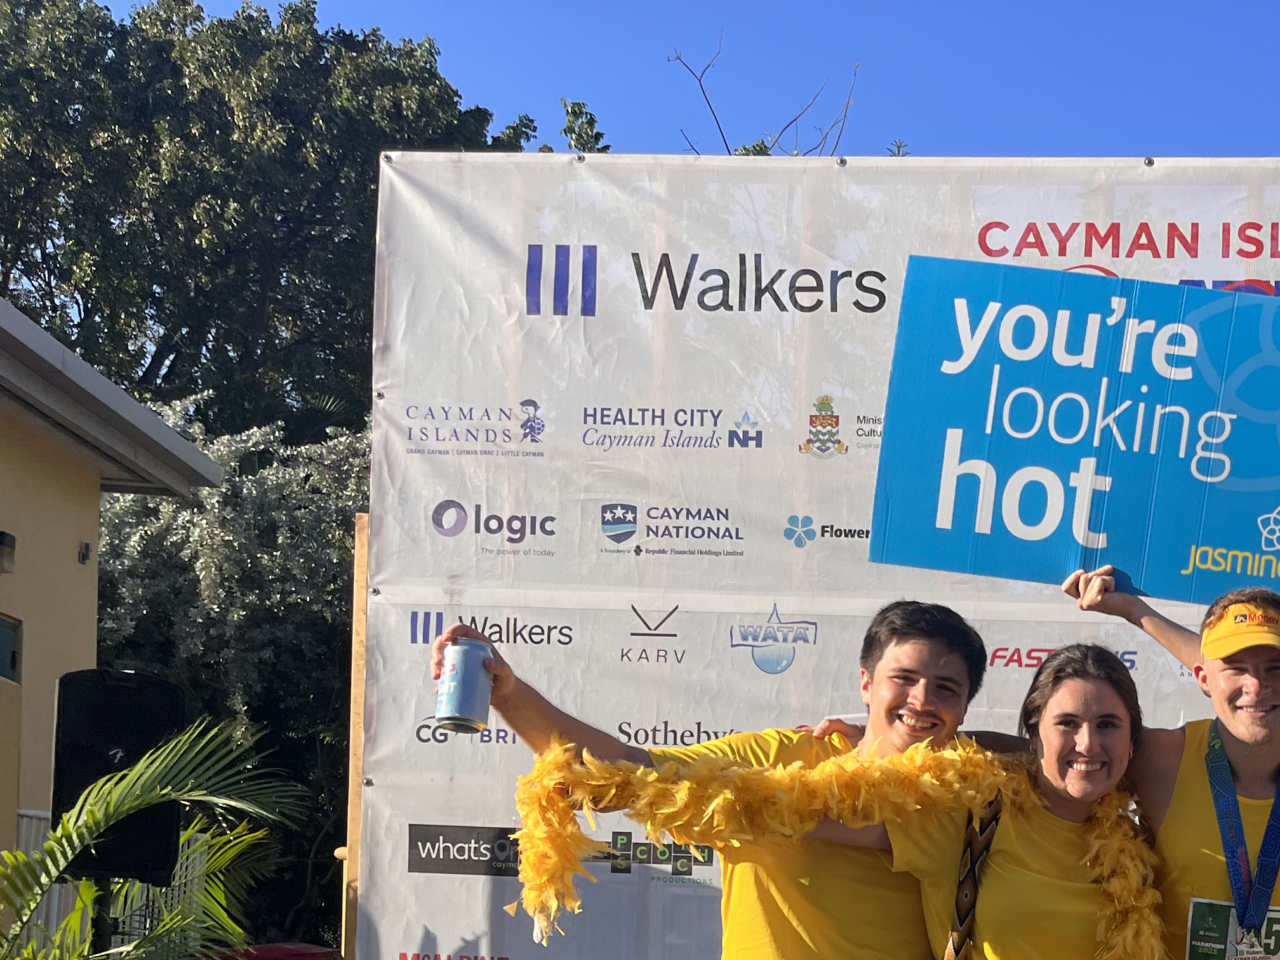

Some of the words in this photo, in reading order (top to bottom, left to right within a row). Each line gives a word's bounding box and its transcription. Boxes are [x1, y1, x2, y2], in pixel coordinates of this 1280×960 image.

[977, 221, 1199, 259] CAYMAN
[631, 251, 887, 313] Walkers
[406, 405, 513, 421] CAYMAN
[582, 407, 666, 426] HEALTH
[673, 408, 723, 427] CITY
[984, 363, 1238, 483] looking
[406, 427, 513, 443] ISLANDS
[582, 427, 656, 452] Cayman
[661, 428, 722, 449] Islands
[728, 430, 763, 448] NH
[935, 428, 1113, 549] hot
[474, 504, 557, 544] logic
[646, 507, 730, 521] CAYMAN
[645, 525, 744, 541] NATIONAL
[481, 547, 494, 555] The
[497, 549, 520, 558] power
[523, 547, 534, 556] of
[535, 548, 556, 558] today
[738, 624, 810, 645] WATA
[620, 648, 687, 664] KARV
[415, 724, 449, 744] CG
[417, 835, 491, 861] what's
[650, 875, 714, 885] PRODUCTIONS
[1191, 940, 1226, 950] MARATHON
